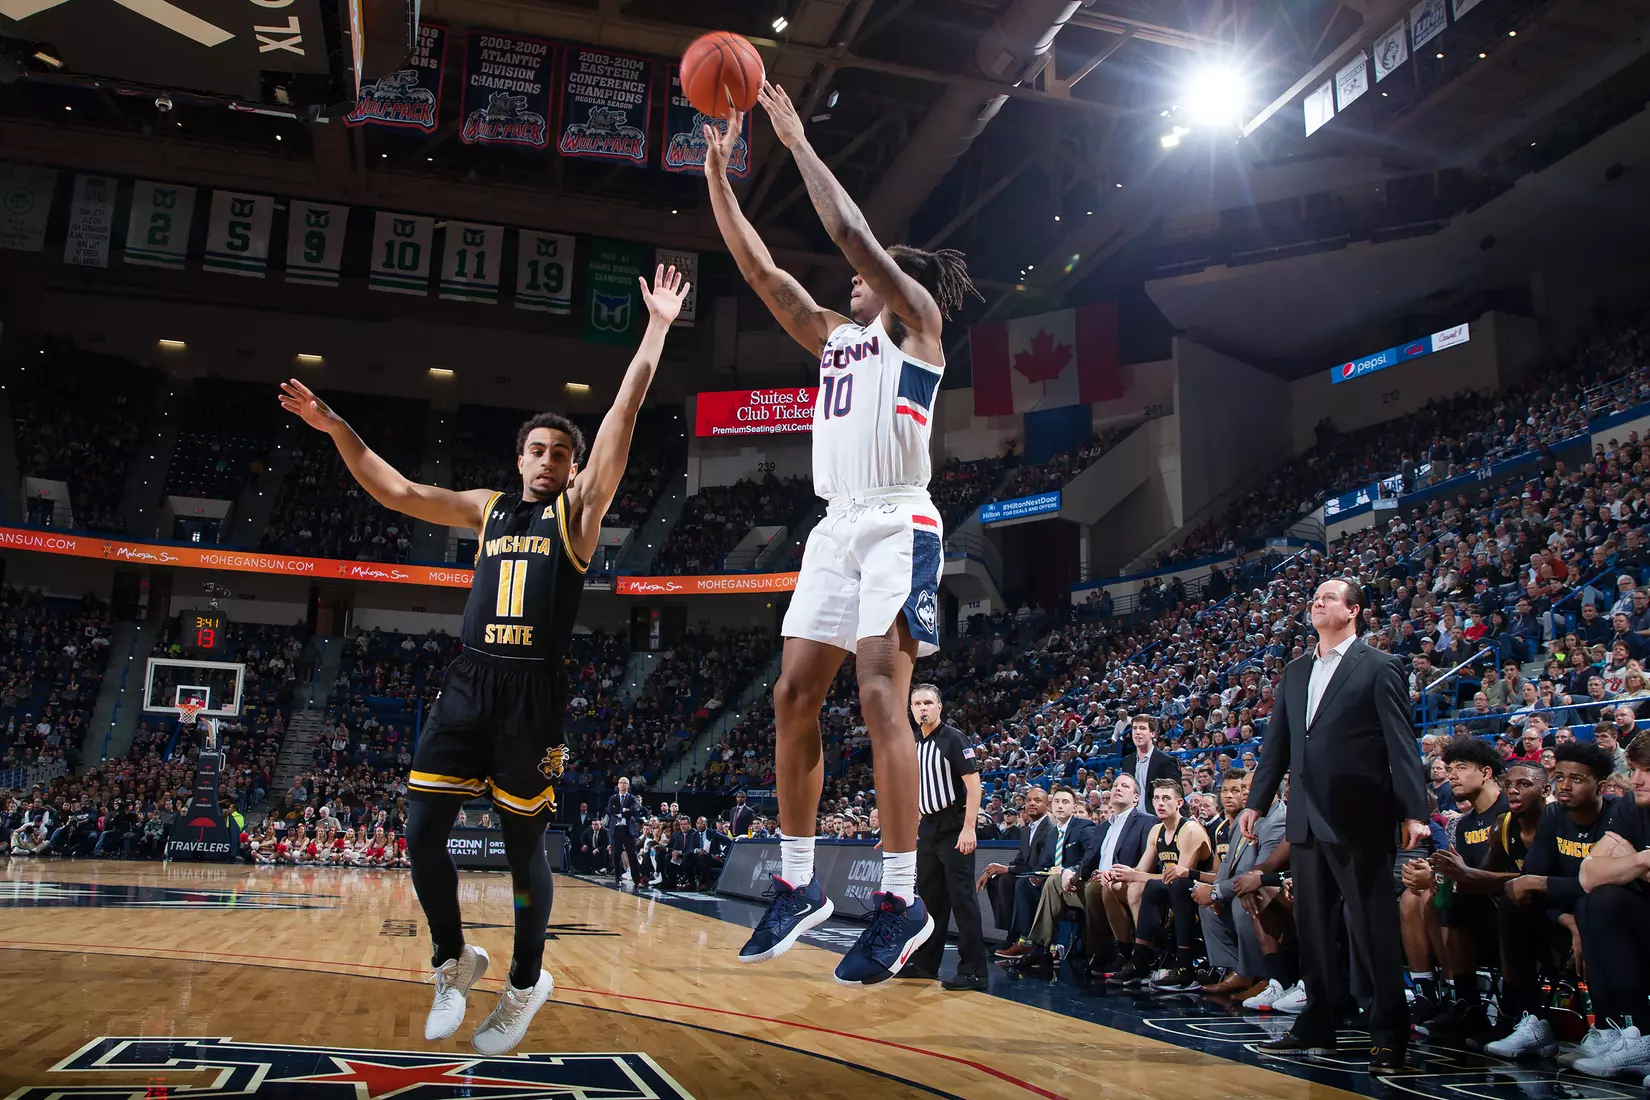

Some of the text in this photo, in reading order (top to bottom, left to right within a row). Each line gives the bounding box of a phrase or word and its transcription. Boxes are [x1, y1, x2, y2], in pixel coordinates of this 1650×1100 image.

[479, 36, 548, 56] 2003-2004
[480, 48, 541, 68] ATLANTIC
[579, 51, 645, 71] 2003-2004
[480, 62, 535, 81] DIVISION
[580, 62, 640, 81] EASTERN
[470, 74, 542, 95] CHAMPIONS
[569, 73, 646, 93] CONFERENCE
[568, 83, 643, 104] CHAMPIONS
[575, 96, 633, 109] REGULAR SEASON
[147, 212, 172, 247] 2
[226, 219, 252, 252] 5
[303, 229, 327, 263] 9
[382, 239, 421, 271] 10
[454, 248, 486, 279] 11
[525, 260, 564, 294] 19
[594, 272, 632, 285] CHAMPIONS
[821, 336, 880, 369] CONN
[1357, 353, 1387, 373] pepsi
[750, 388, 810, 405] Suites &
[822, 372, 853, 421] 10
[736, 404, 815, 421] Club Ticket
[712, 423, 814, 434] PremiumSeating@XLCente
[757, 461, 776, 472] 239
[982, 511, 1001, 519] Hilton
[1013, 507, 1028, 515] DEALS
[1039, 502, 1058, 510] OFFERS
[485, 535, 551, 557] WCHITA
[0, 533, 77, 550] ANSUN.COM
[116, 547, 158, 561] Mohegan
[160, 551, 179, 562] Sun
[200, 554, 315, 572] MOHEGANSUN.COM
[351, 566, 390, 579] Mohegan
[390, 569, 409, 580] Sun
[496, 560, 529, 617] 11
[629, 577, 799, 592] Mohegan Sun MOHEGANSUN.COM
[196, 616, 219, 628] 3:41
[197, 629, 215, 648] 13
[484, 623, 534, 646] STATE
[169, 841, 231, 853] TRAVELERS
[848, 859, 883, 882] UCONN
[844, 884, 874, 900] HEALTH
